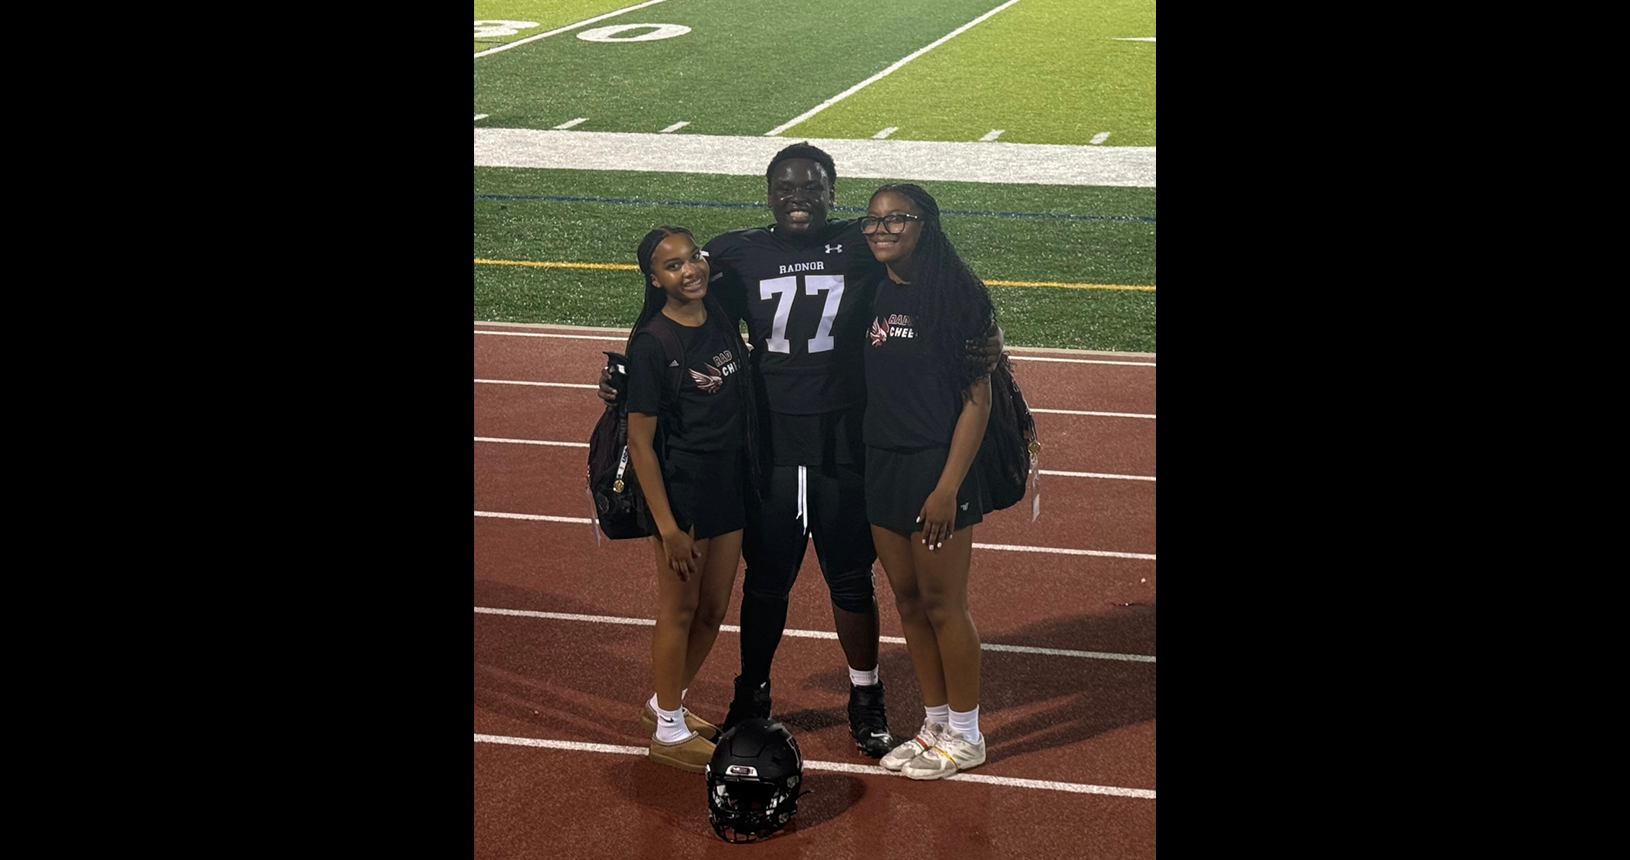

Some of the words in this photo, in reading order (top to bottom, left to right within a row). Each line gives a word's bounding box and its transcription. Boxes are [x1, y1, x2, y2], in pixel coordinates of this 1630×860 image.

[779, 261, 825, 274] RADNOR
[759, 274, 845, 354] 77
[889, 326, 918, 338] CHEE
[712, 349, 733, 368] RAD
